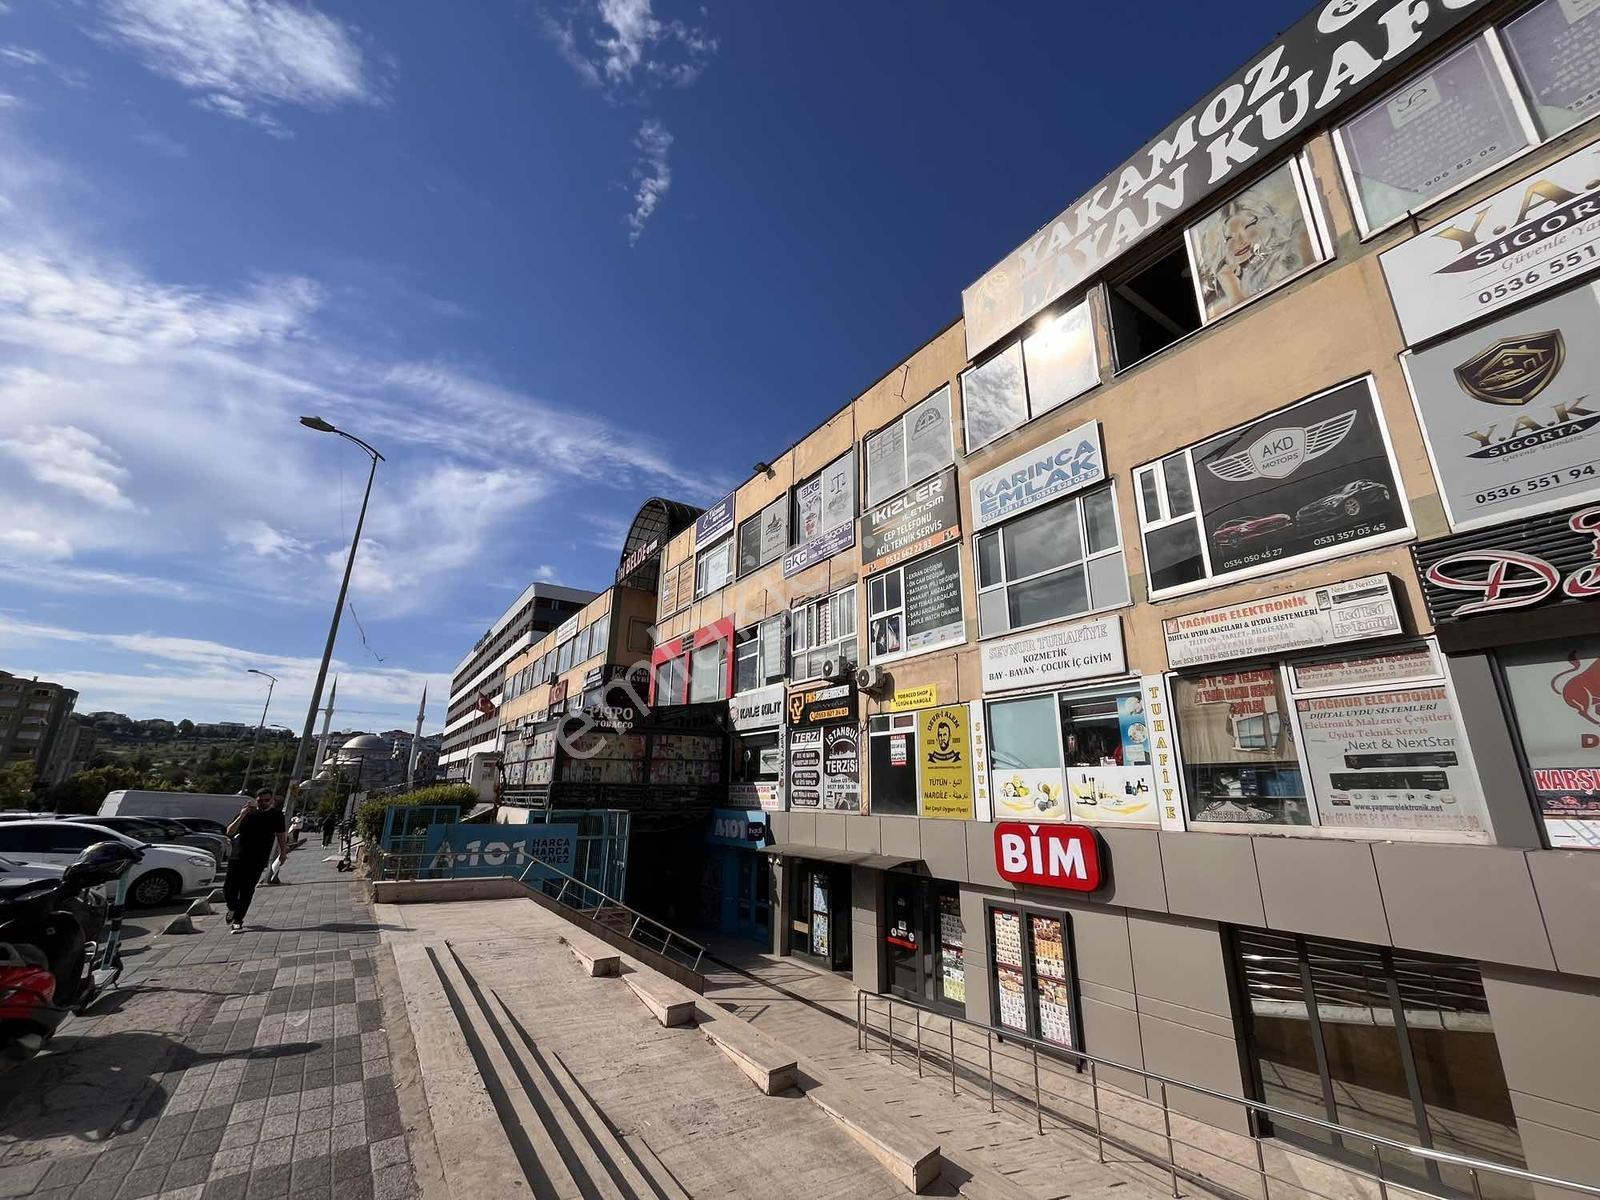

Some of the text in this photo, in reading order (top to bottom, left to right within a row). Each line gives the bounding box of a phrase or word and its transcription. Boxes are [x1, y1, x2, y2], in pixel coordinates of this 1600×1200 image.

[1020, 46, 1290, 273] YAKAMOZ
[1021, 162, 1188, 316] BAYAN
[1206, 0, 1476, 184] KUAF
[1478, 245, 1597, 304] 0536 551
[1262, 436, 1294, 458] AKD
[1262, 452, 1299, 469] MOTORS
[980, 452, 1097, 516] EMLAK
[1475, 465, 1596, 504] 0536 551 94
[989, 671, 1004, 681] BAY
[1009, 666, 1035, 678] BAYAN
[1023, 646, 1068, 664] KOZMETİK
[740, 706, 760, 720] KALE
[1149, 687, 1176, 819] TUHAFİYE
[1348, 735, 1456, 751] Next & NextStar
[1001, 825, 1088, 880] BİM
